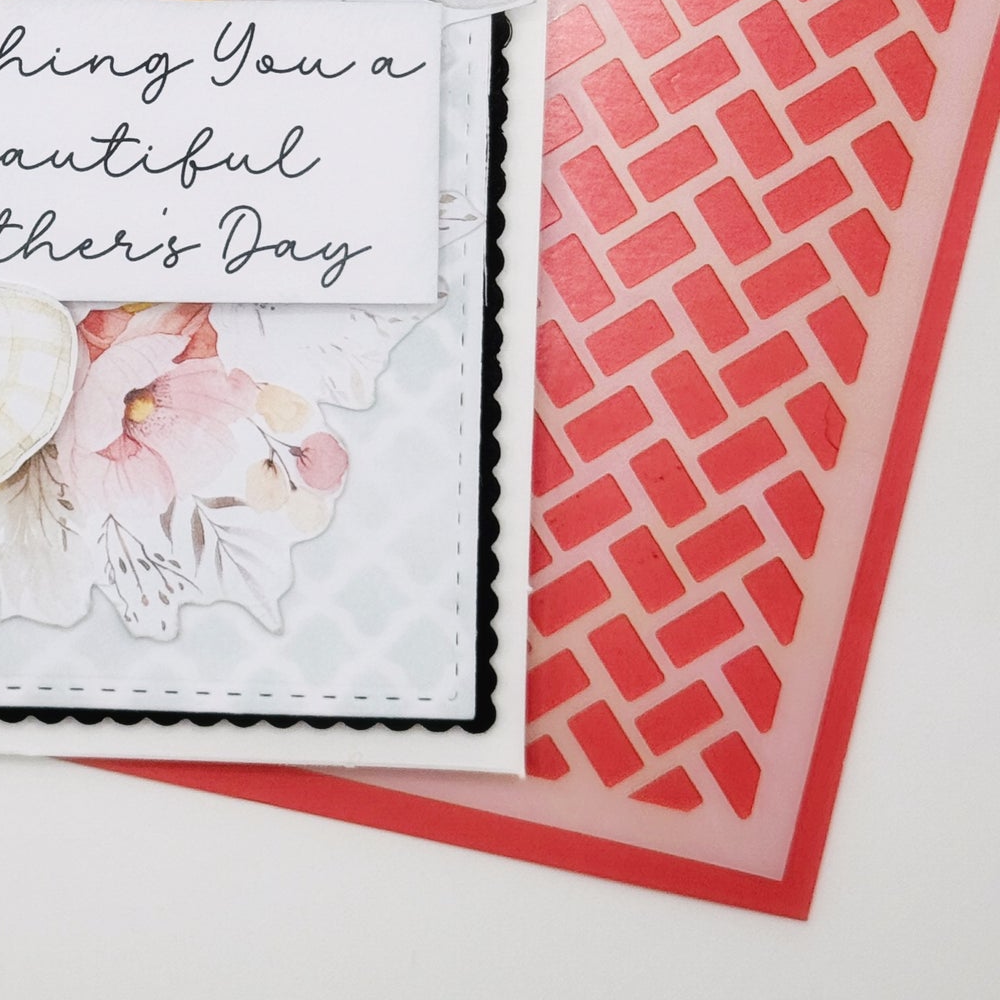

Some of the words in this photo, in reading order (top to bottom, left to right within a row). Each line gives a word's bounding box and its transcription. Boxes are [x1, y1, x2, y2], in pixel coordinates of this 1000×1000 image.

[210, 20, 356, 86] You
[371, 56, 426, 79] a
[218, 204, 373, 288] Day
